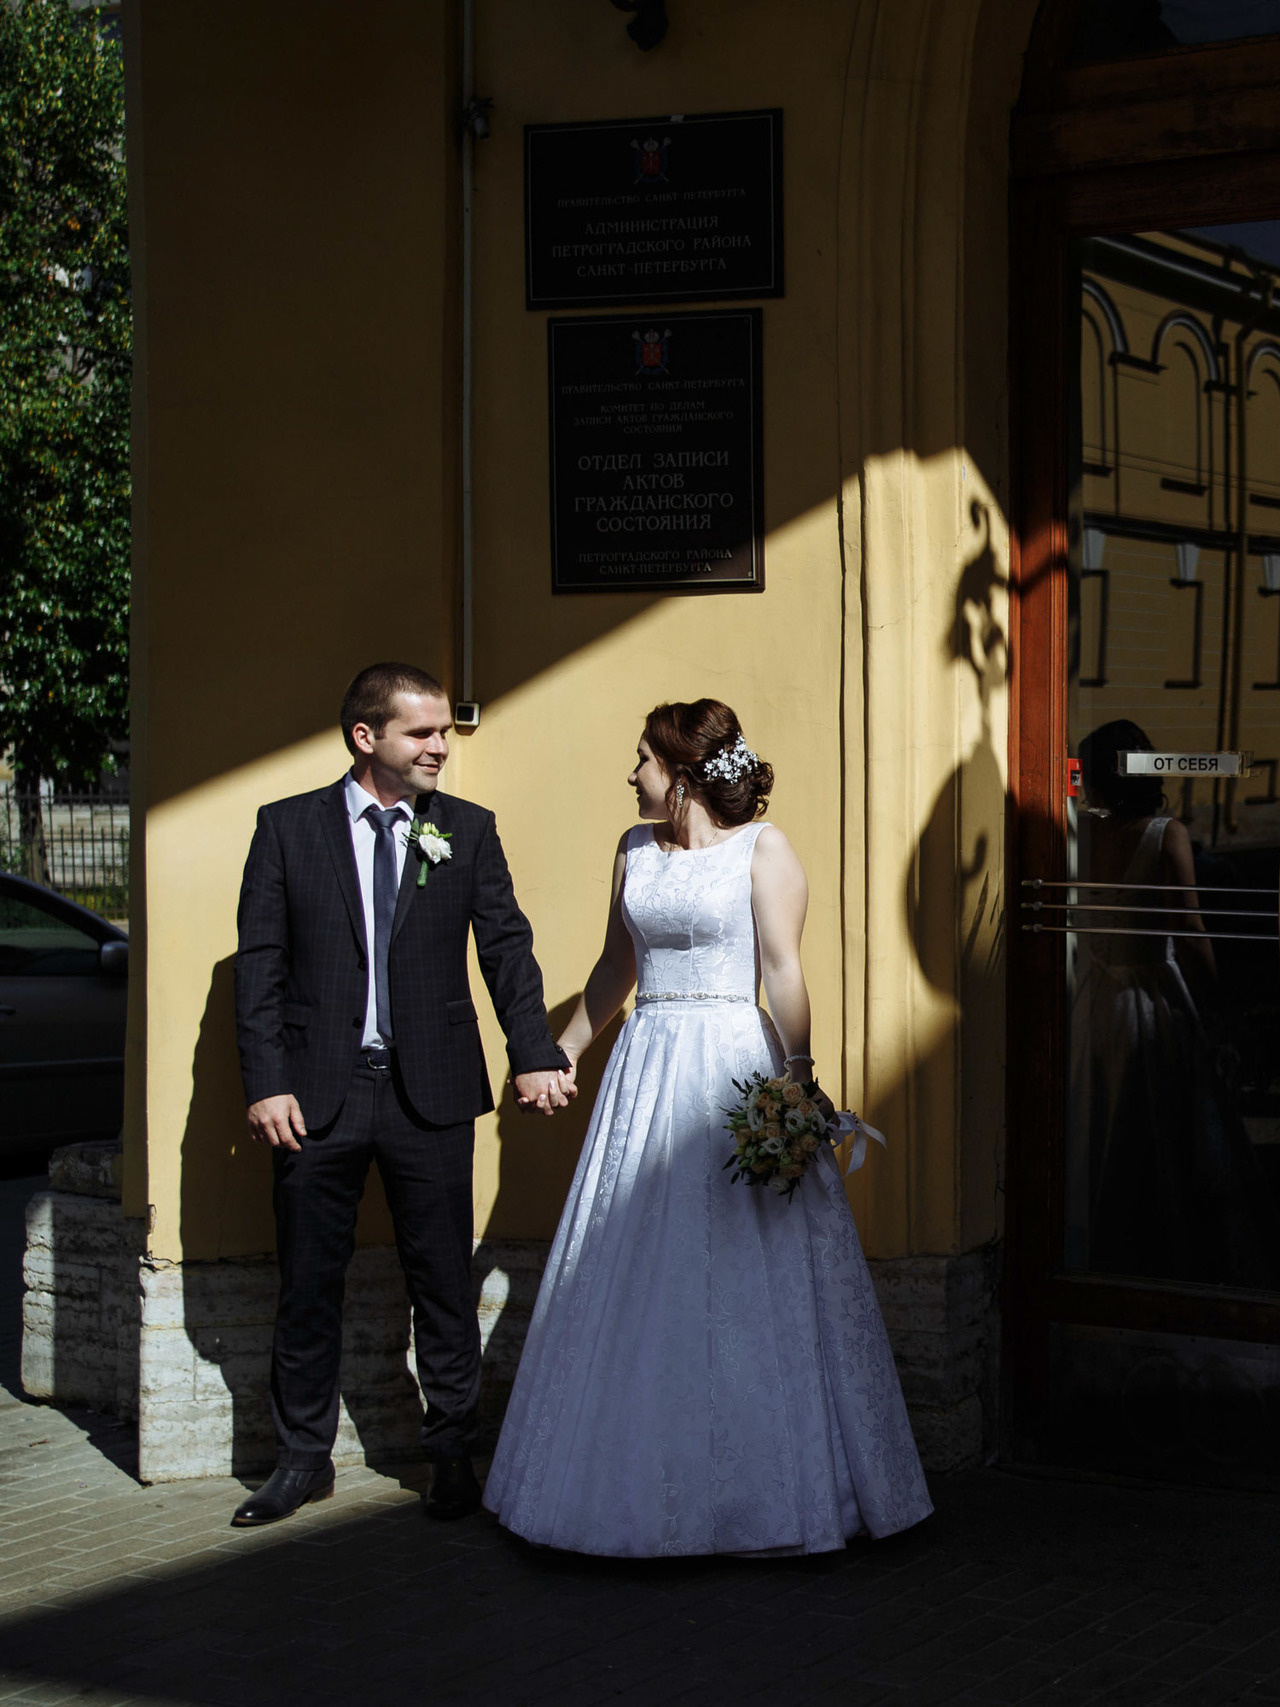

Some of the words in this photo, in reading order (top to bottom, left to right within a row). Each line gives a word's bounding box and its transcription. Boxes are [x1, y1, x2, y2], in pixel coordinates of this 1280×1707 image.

[557, 193, 640, 209] ПРАВИТЕЛЬСТВО
[584, 215, 719, 236] АДМИНИСТРАЦИЯ
[551, 238, 685, 259] ПЕТРОГРАДСКОГО
[693, 234, 752, 250] РАЙОНА
[561, 383, 642, 395] ПРАВИТЕЛЬСТВО
[600, 403, 646, 414] КОМИТЕТ
[650, 403, 665, 412] ПО
[669, 400, 705, 411] ДЕЛАМ
[573, 415, 612, 426] ЗАПИСИ
[616, 414, 648, 424] АКТОВ
[652, 410, 734, 423] ГРАЖДАНСКОГО
[623, 424, 683, 435] СОСТОЯНИЯ
[577, 453, 642, 472] ОТДЕЛ
[652, 450, 729, 469] ЗАПИСИ
[622, 472, 685, 490] АКТОВ
[574, 492, 734, 513] ГРАЖДАНСКОГО
[596, 514, 712, 532] СОСТОЯНИЯ
[578, 550, 680, 564] ПЕТРОГРАДСКОГО
[686, 548, 733, 560] РАЙОНА
[1154, 757, 1174, 771] ОТ
[1178, 757, 1219, 771] СЕБЯ
